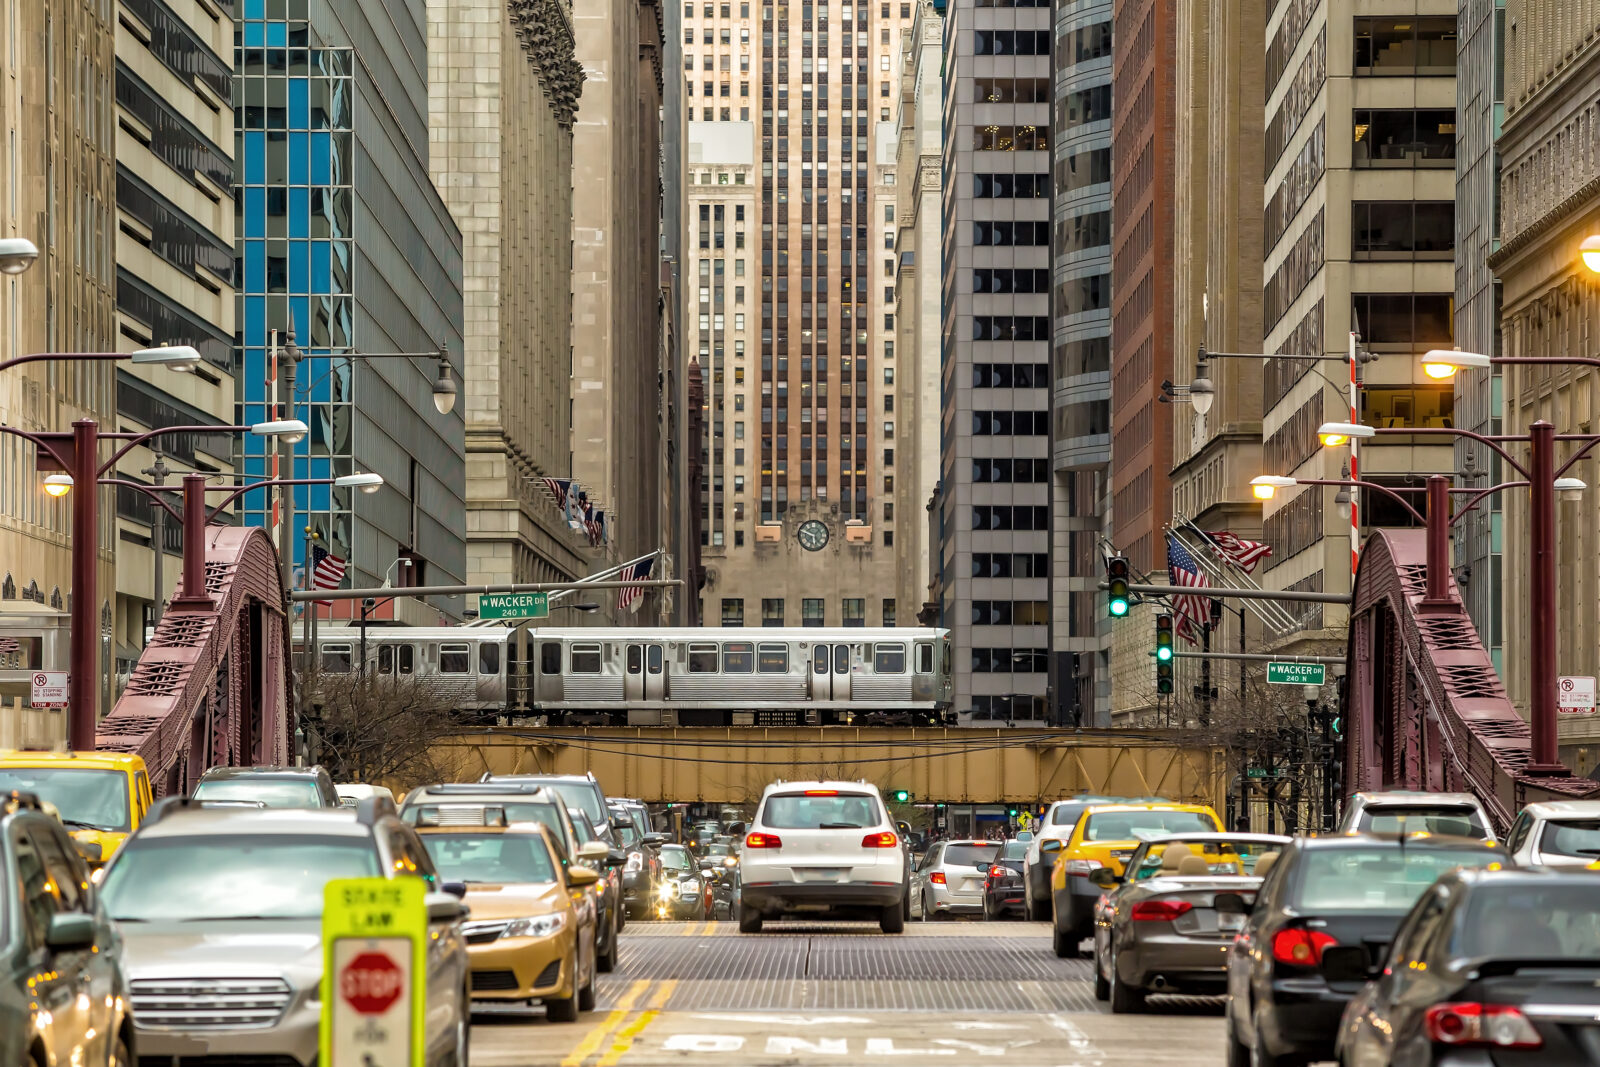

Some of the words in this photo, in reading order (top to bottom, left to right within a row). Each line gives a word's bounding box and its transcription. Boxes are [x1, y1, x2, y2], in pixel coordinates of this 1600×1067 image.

[482, 599, 488, 607] W
[490, 596, 533, 607] WACKER
[534, 597, 545, 605] DR
[1277, 665, 1312, 675] WACKER
[344, 886, 402, 907] STATE
[351, 912, 392, 930] LAW
[342, 968, 401, 998] STOP
[662, 1034, 1040, 1056] ONLY
